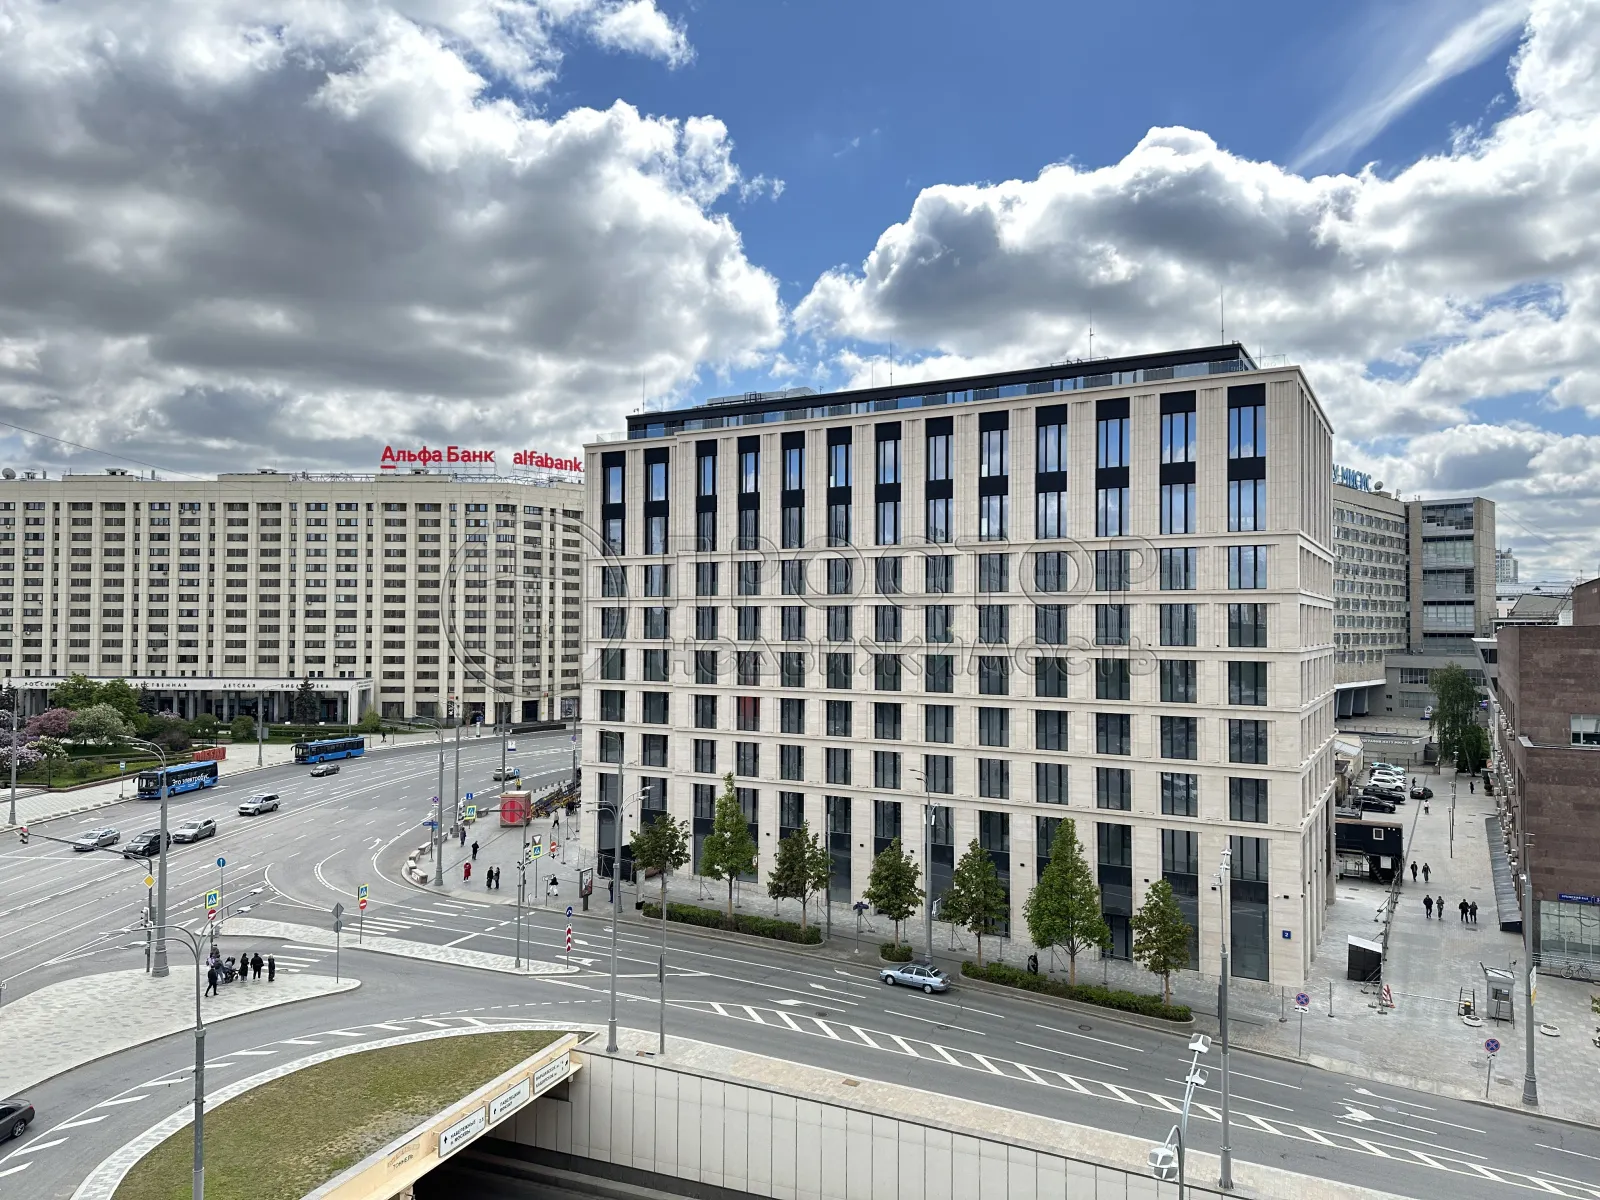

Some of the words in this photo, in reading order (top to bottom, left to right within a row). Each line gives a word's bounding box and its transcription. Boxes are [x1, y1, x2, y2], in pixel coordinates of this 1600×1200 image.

[381, 446, 442, 467] Альфа
[447, 446, 495, 463] Банк
[171, 778, 182, 787] Это
